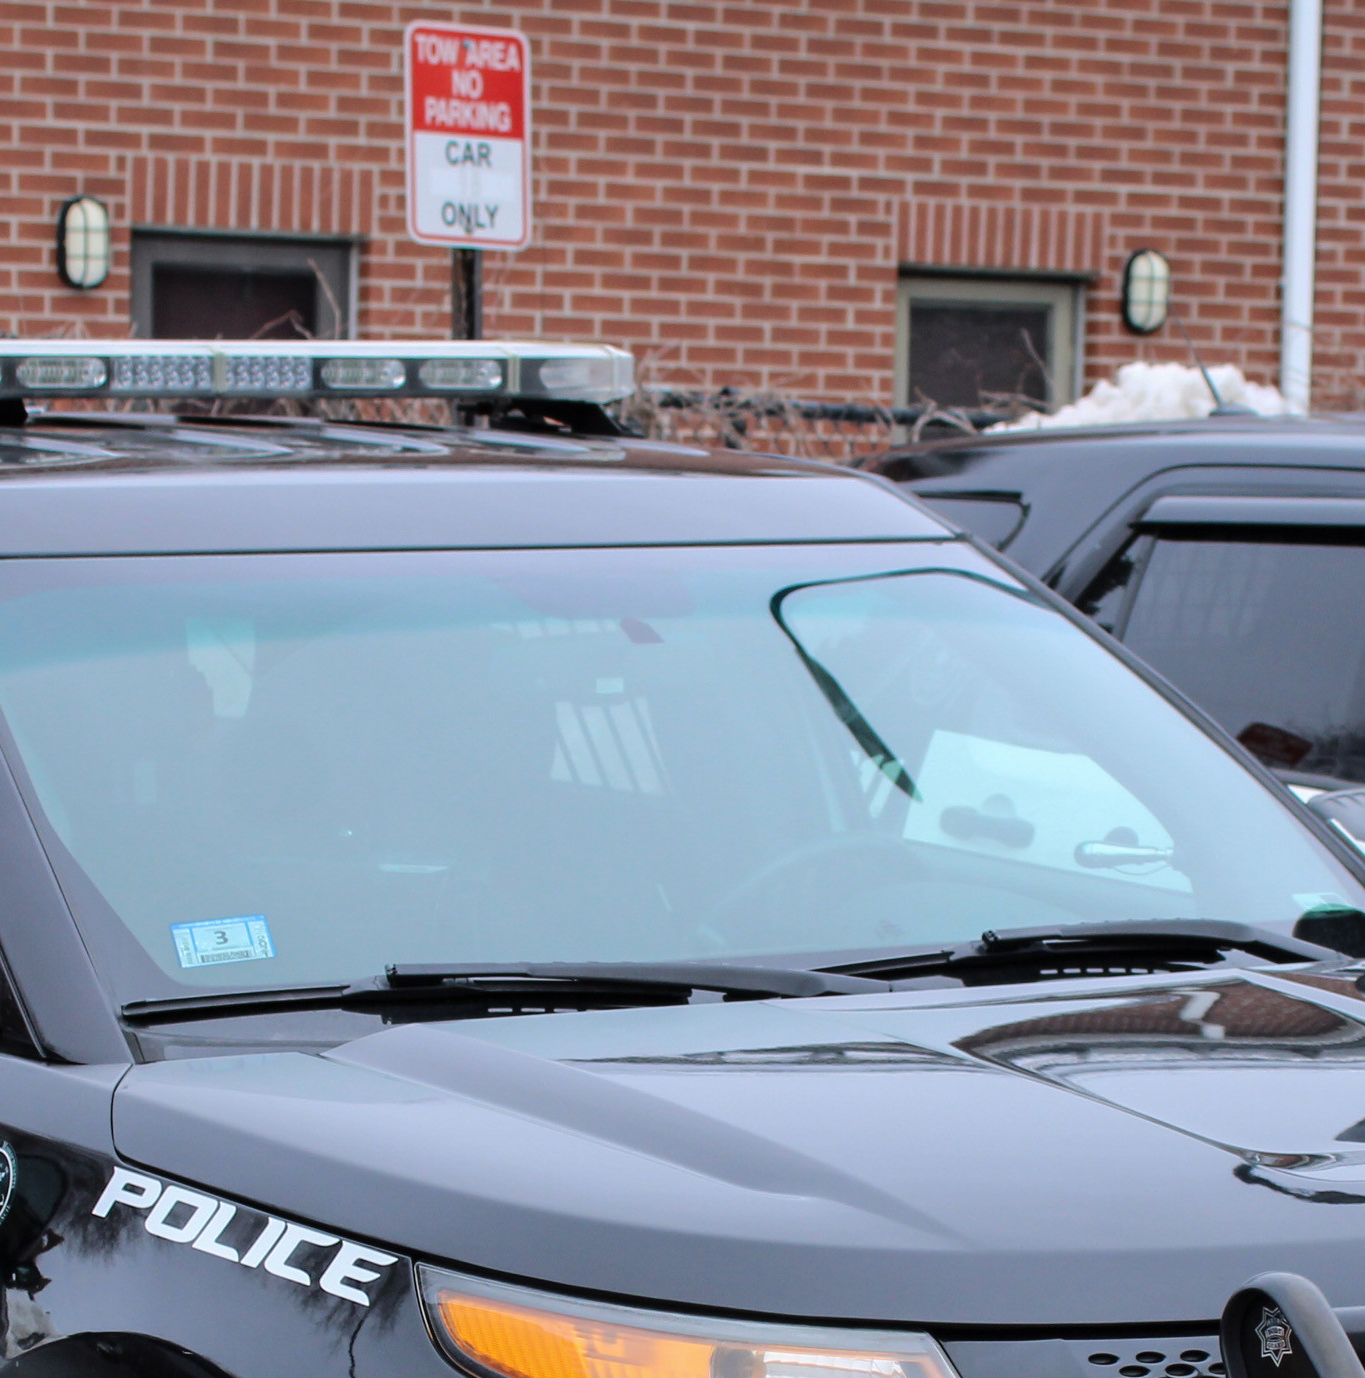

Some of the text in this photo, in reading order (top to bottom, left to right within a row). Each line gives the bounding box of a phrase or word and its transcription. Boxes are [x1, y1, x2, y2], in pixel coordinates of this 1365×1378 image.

[415, 34, 521, 71] TOW AREA
[451, 69, 483, 99] NO
[424, 97, 512, 132] PARKING
[445, 140, 492, 166] CAR
[442, 201, 499, 229] ONLY
[214, 930, 228, 945] 3
[91, 1166, 399, 1307] POLICE
